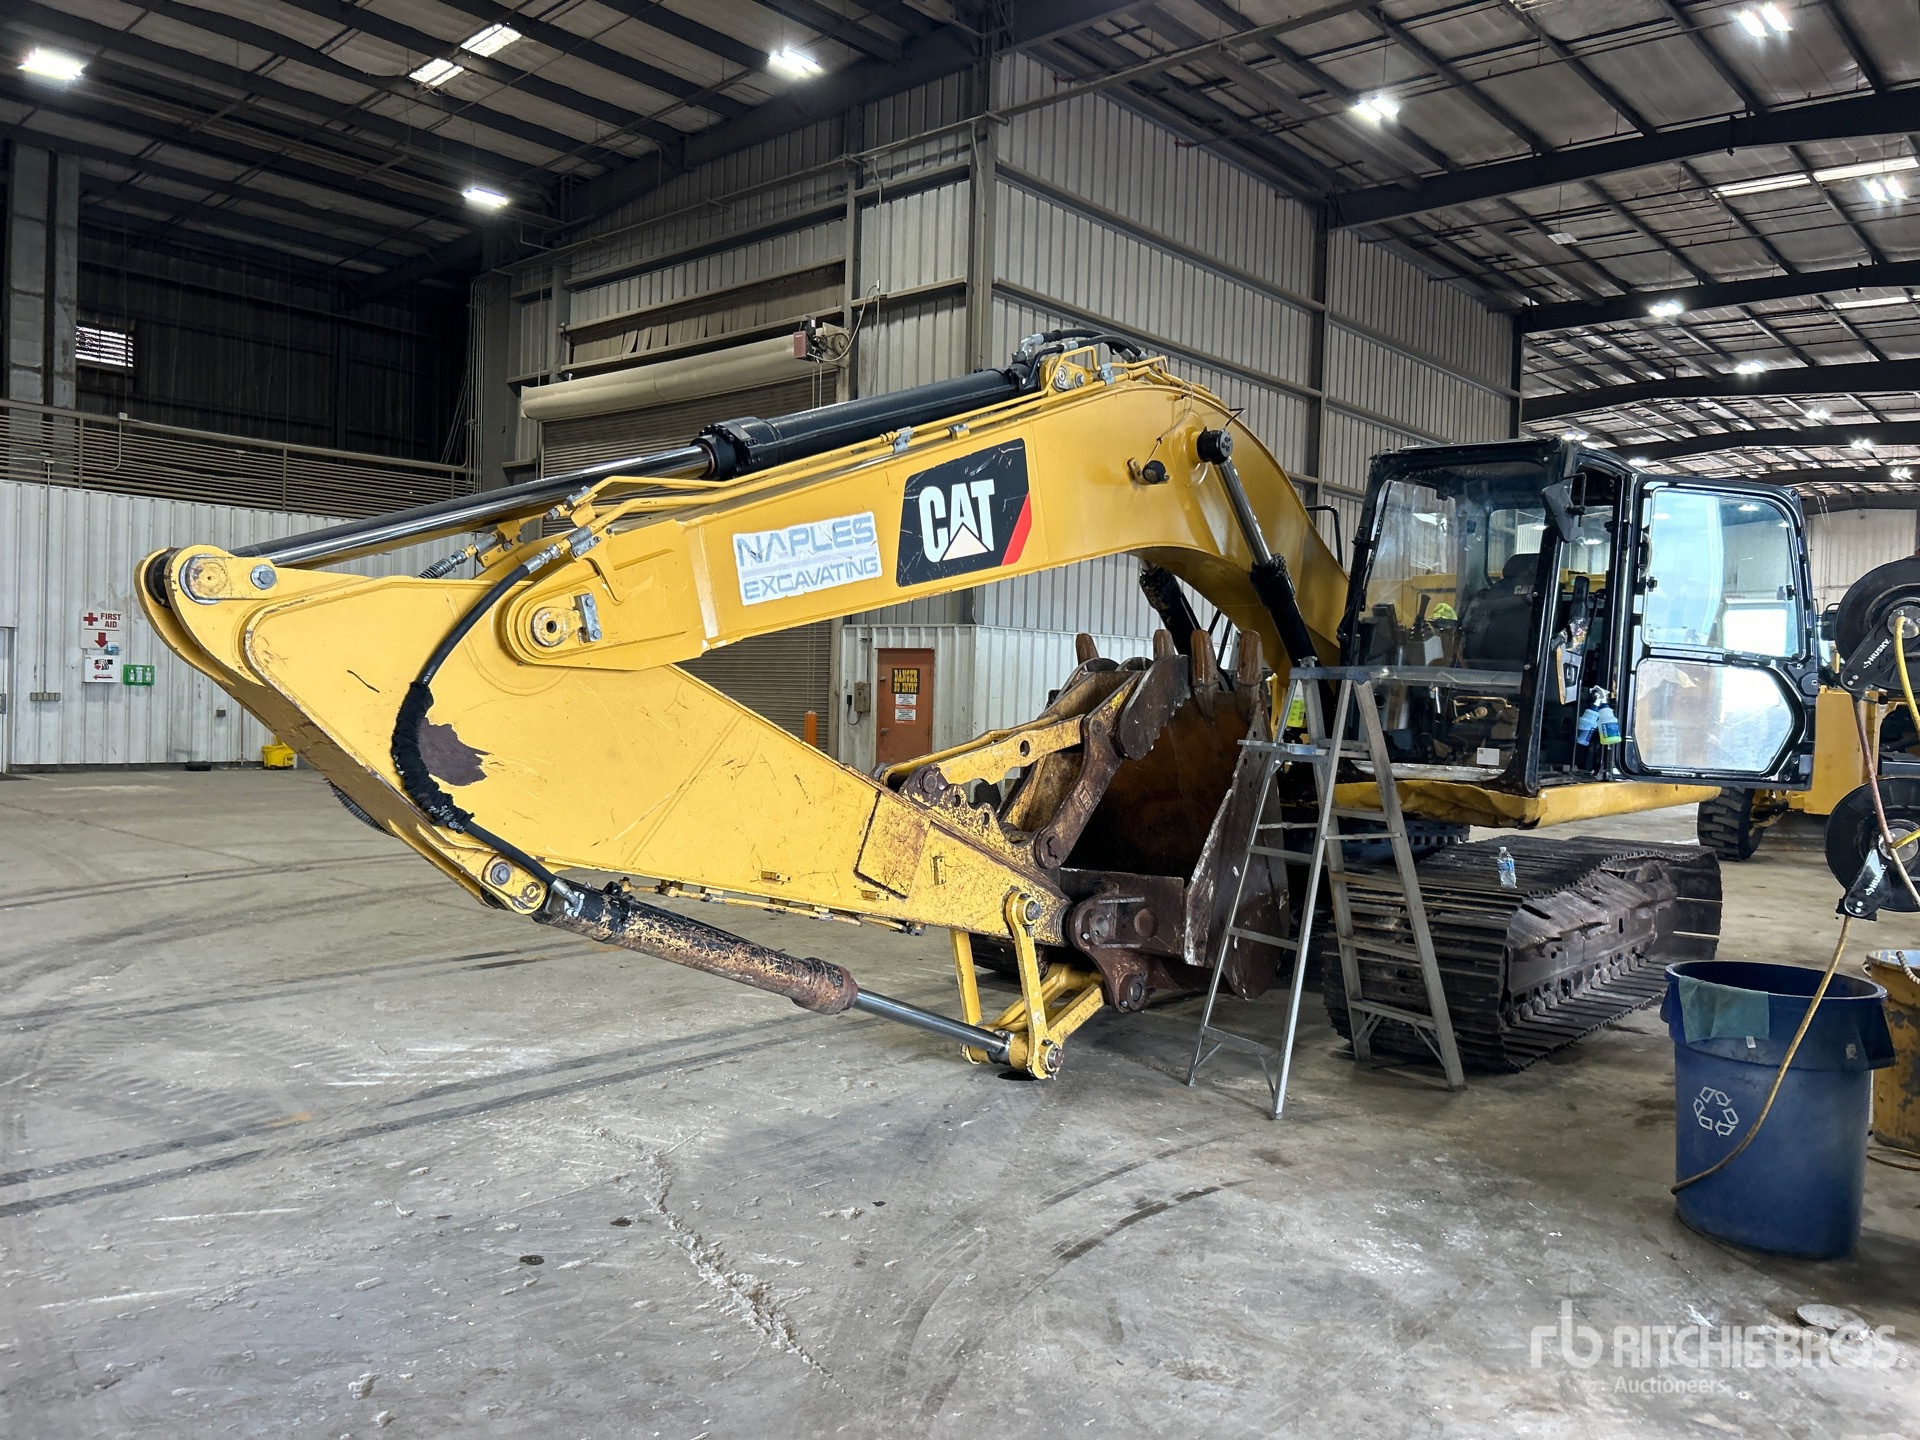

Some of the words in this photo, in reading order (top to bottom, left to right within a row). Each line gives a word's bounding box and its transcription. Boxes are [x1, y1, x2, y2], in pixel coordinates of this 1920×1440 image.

[918, 478, 995, 563] CAT
[736, 515, 875, 567] NAPLES
[743, 556, 879, 600] EXCAVATING
[100, 612, 122, 621] FIRST
[104, 620, 118, 628] AID
[1868, 638, 1890, 662] HUSKY
